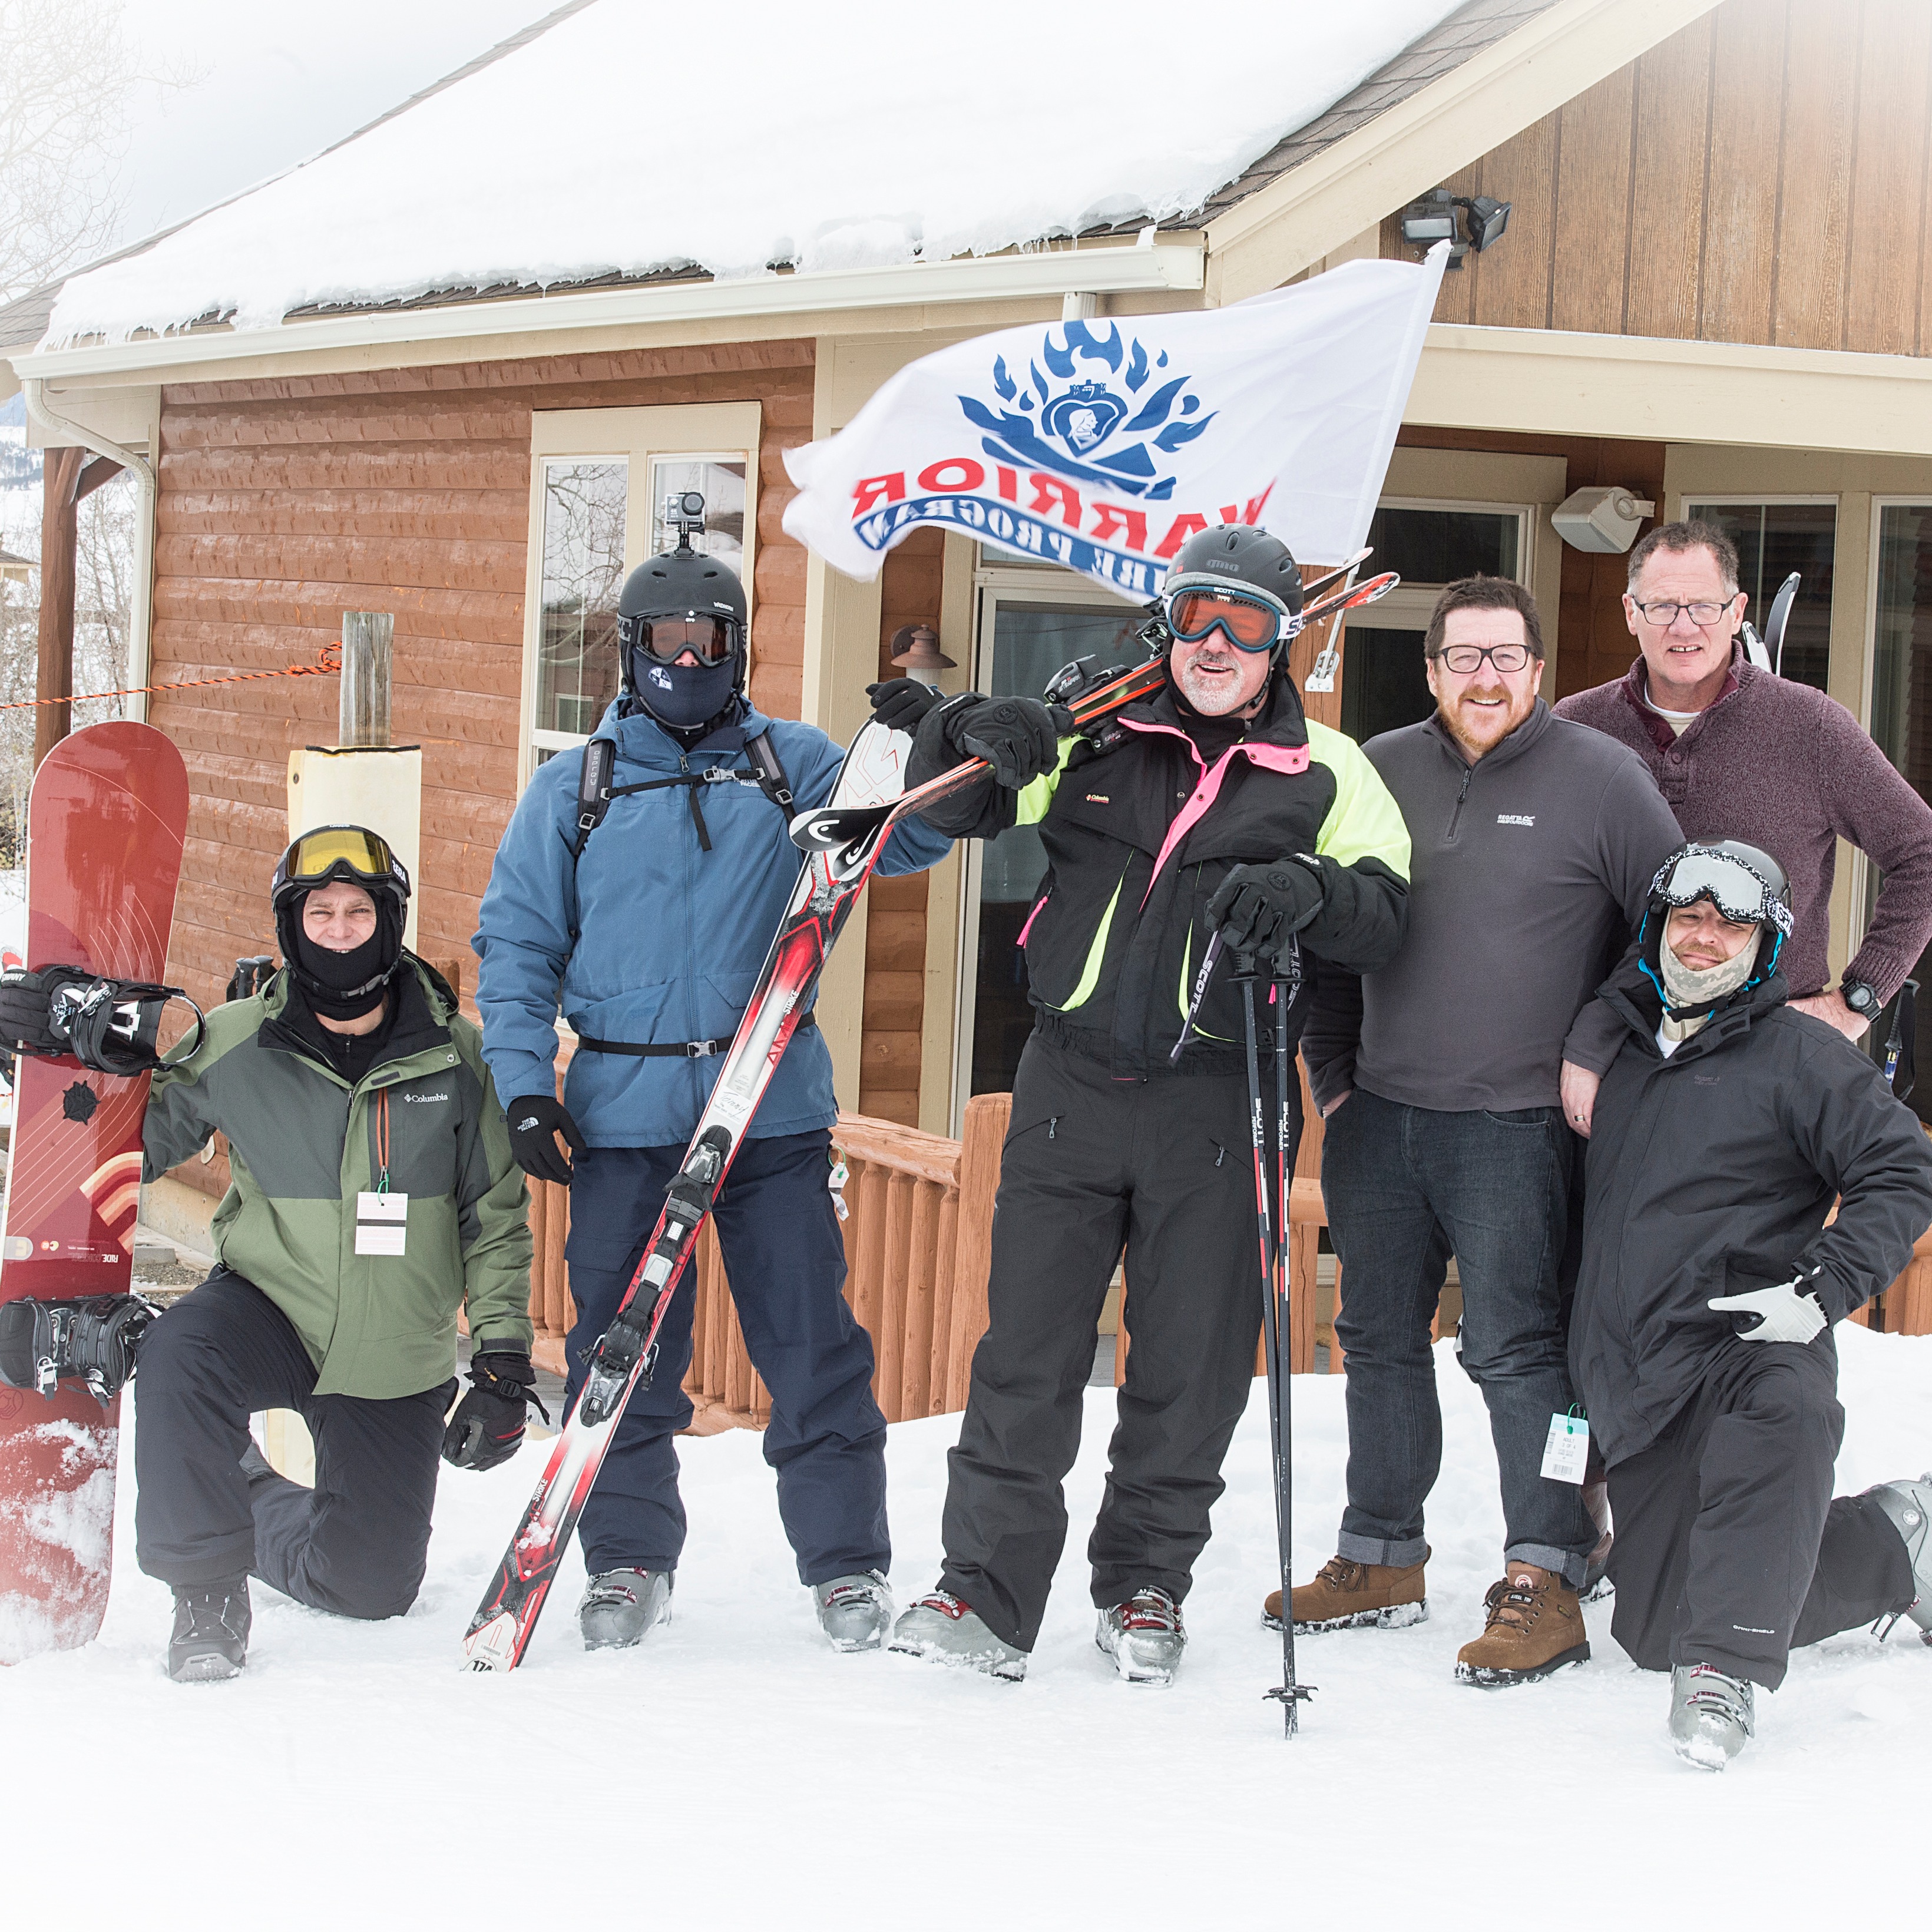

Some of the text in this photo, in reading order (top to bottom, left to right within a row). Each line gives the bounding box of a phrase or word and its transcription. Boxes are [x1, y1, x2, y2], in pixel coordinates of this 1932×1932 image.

[1213, 587, 1236, 596] SCOTT
[1190, 960, 1213, 1014] SCOTT
[782, 990, 800, 1015] STRIKE
[411, 1093, 448, 1103] Columbia
[532, 1478, 548, 1502] STRIKE
